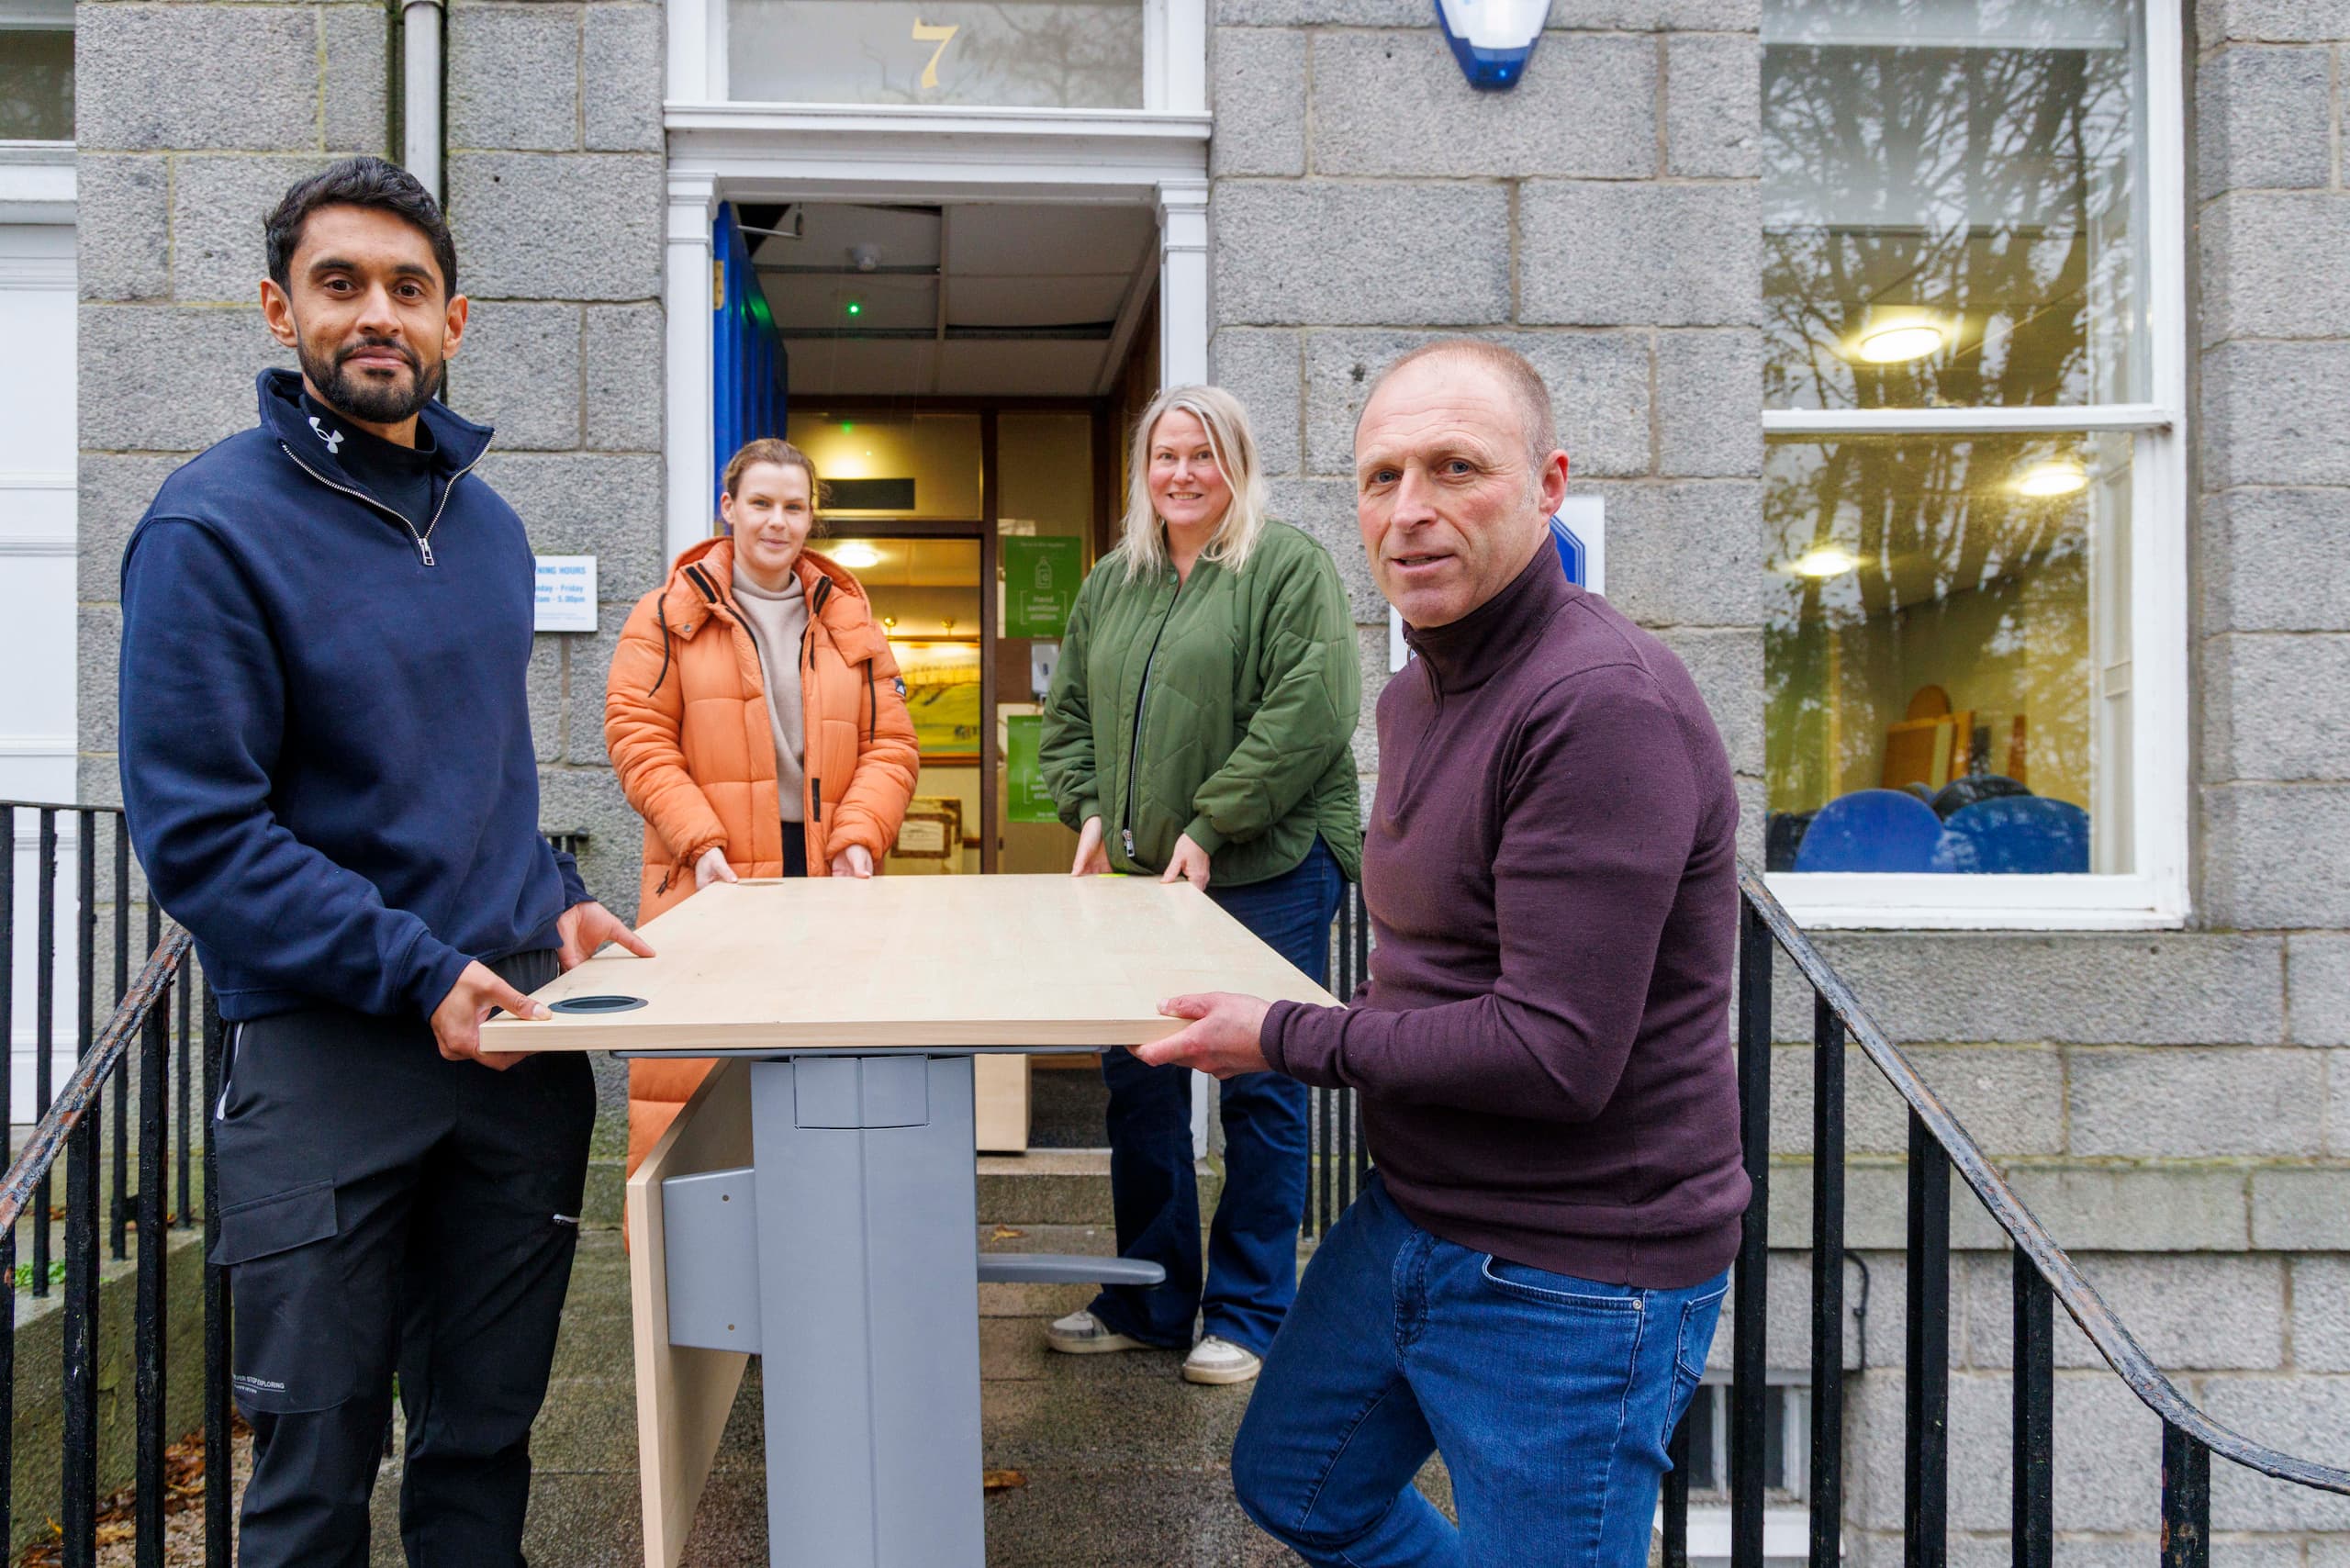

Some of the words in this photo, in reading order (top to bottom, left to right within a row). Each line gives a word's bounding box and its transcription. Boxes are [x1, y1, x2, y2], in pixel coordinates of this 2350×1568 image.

[912, 17, 960, 89] 7
[536, 566, 556, 575] NING
[559, 566, 586, 575] HOURS
[536, 584, 553, 593] nday
[561, 584, 584, 593] Friday
[257, 1379, 285, 1389] EXPLORING
